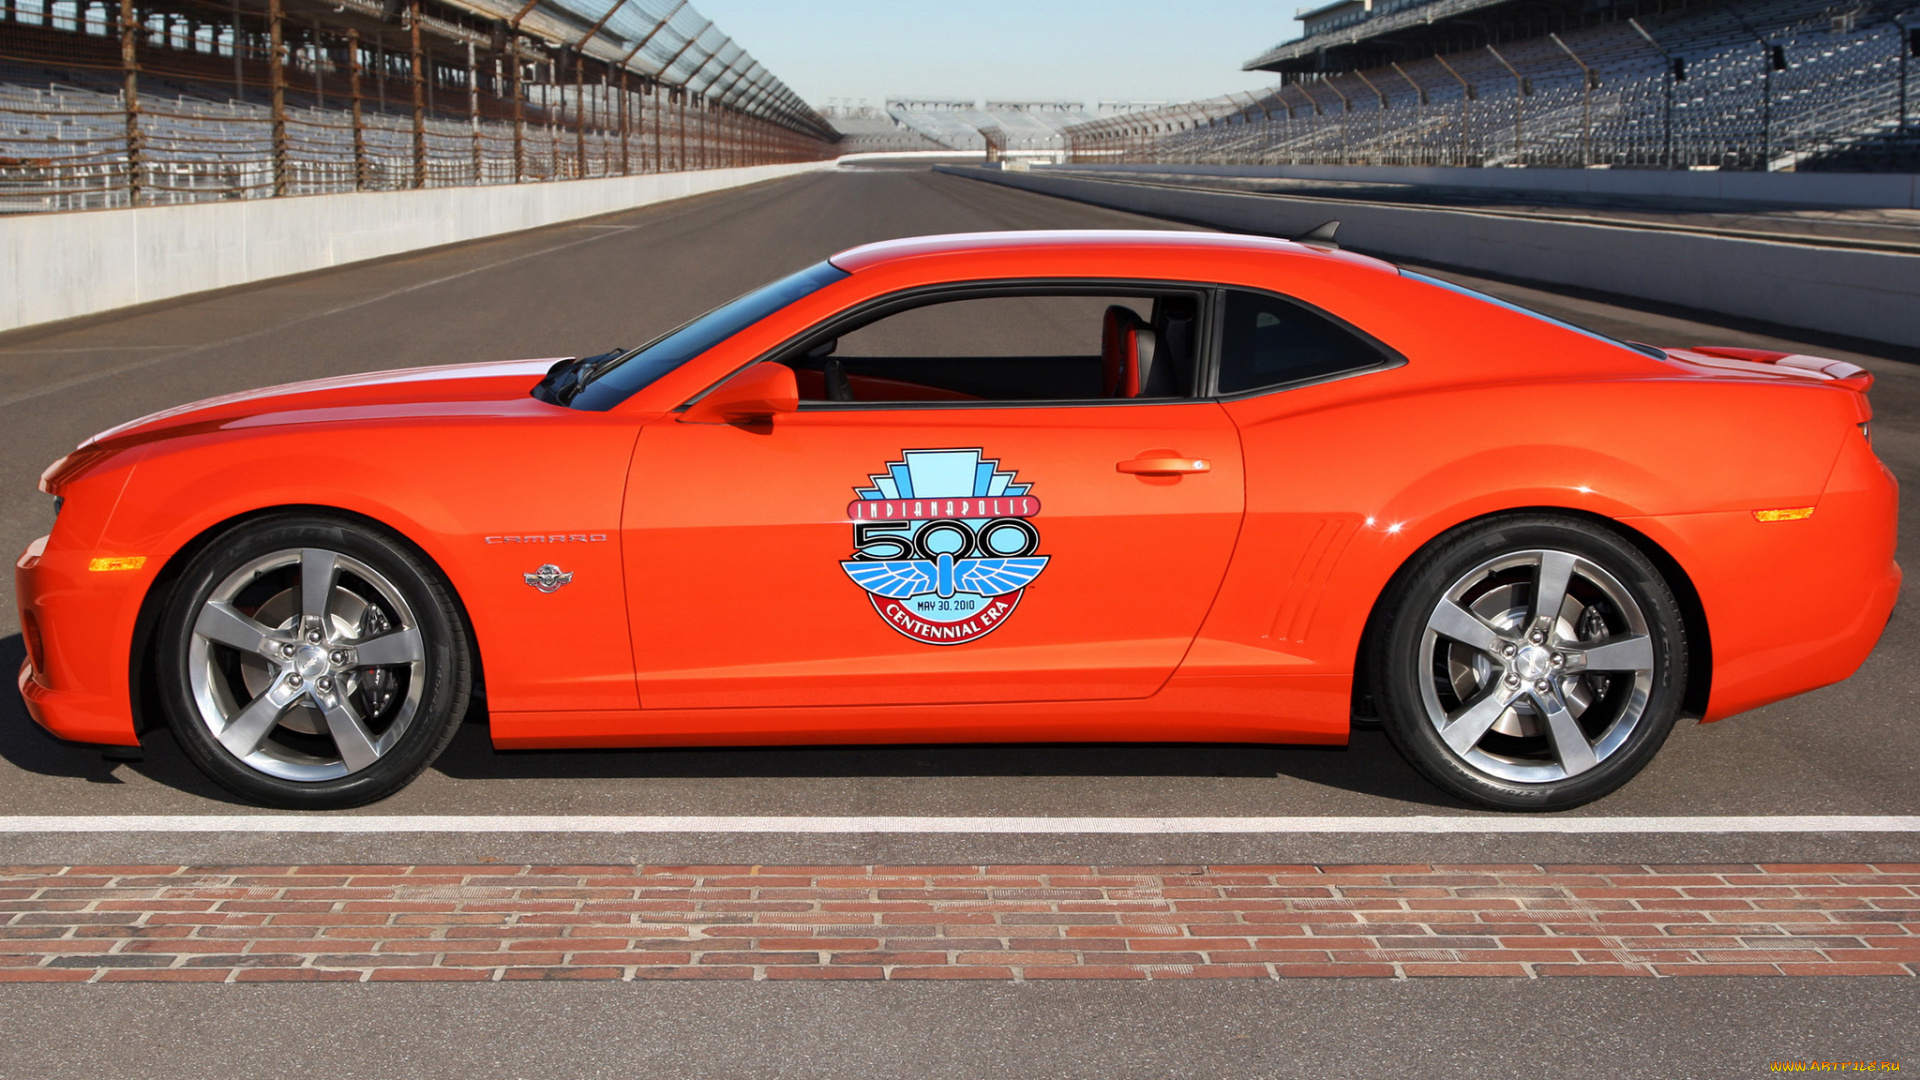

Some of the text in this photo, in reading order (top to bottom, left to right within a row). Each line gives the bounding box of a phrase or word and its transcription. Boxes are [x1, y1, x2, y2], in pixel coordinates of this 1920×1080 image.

[857, 499, 1029, 518] INDIANAPOLIS
[485, 534, 606, 544] CAMARO
[851, 518, 1040, 560] 500
[917, 600, 975, 612] MAY 30, 2010
[886, 600, 1009, 639] CENTENNIAL ERA
